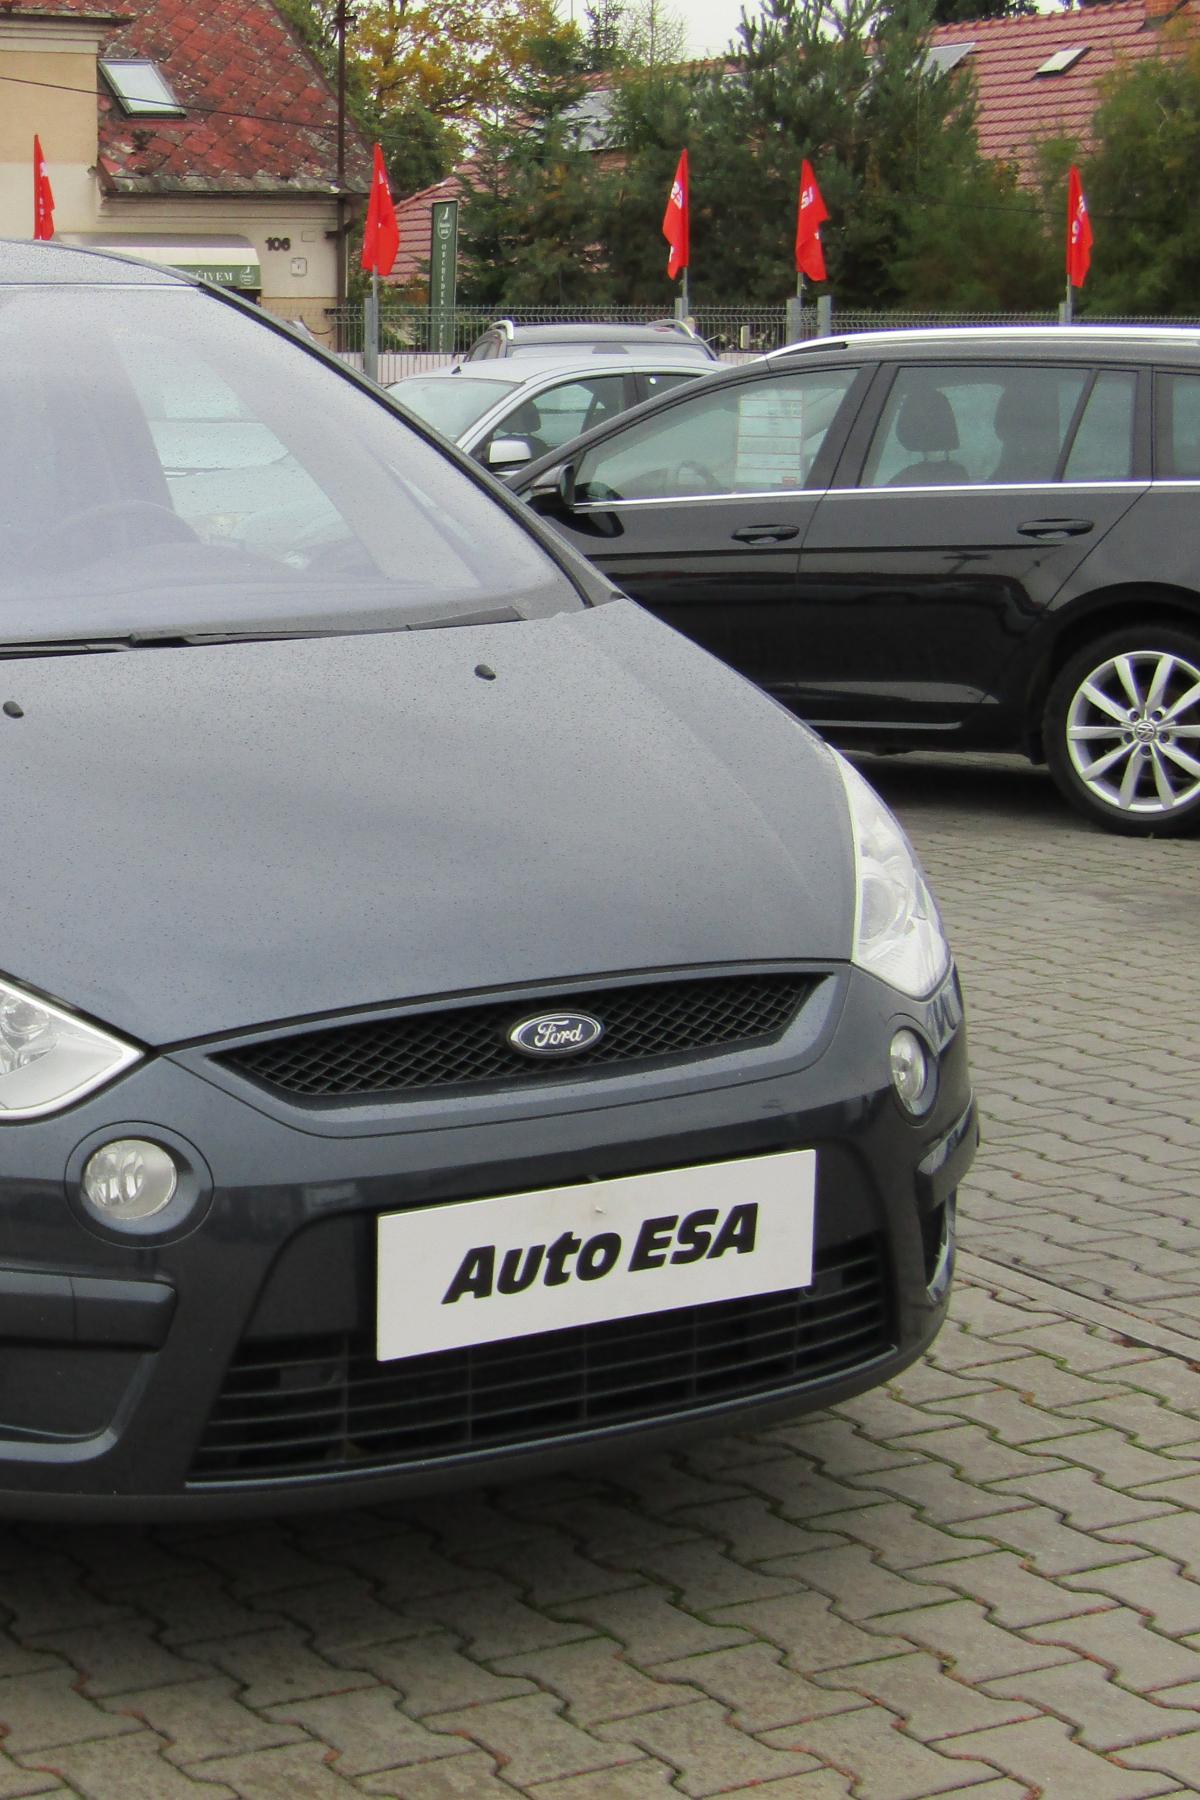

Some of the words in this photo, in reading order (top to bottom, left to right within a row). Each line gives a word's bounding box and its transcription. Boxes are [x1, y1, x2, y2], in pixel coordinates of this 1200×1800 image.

[265, 237, 291, 251] 106
[534, 1019, 584, 1047] Ford
[441, 1230, 622, 1305] Auto
[628, 1202, 759, 1273] ESA
